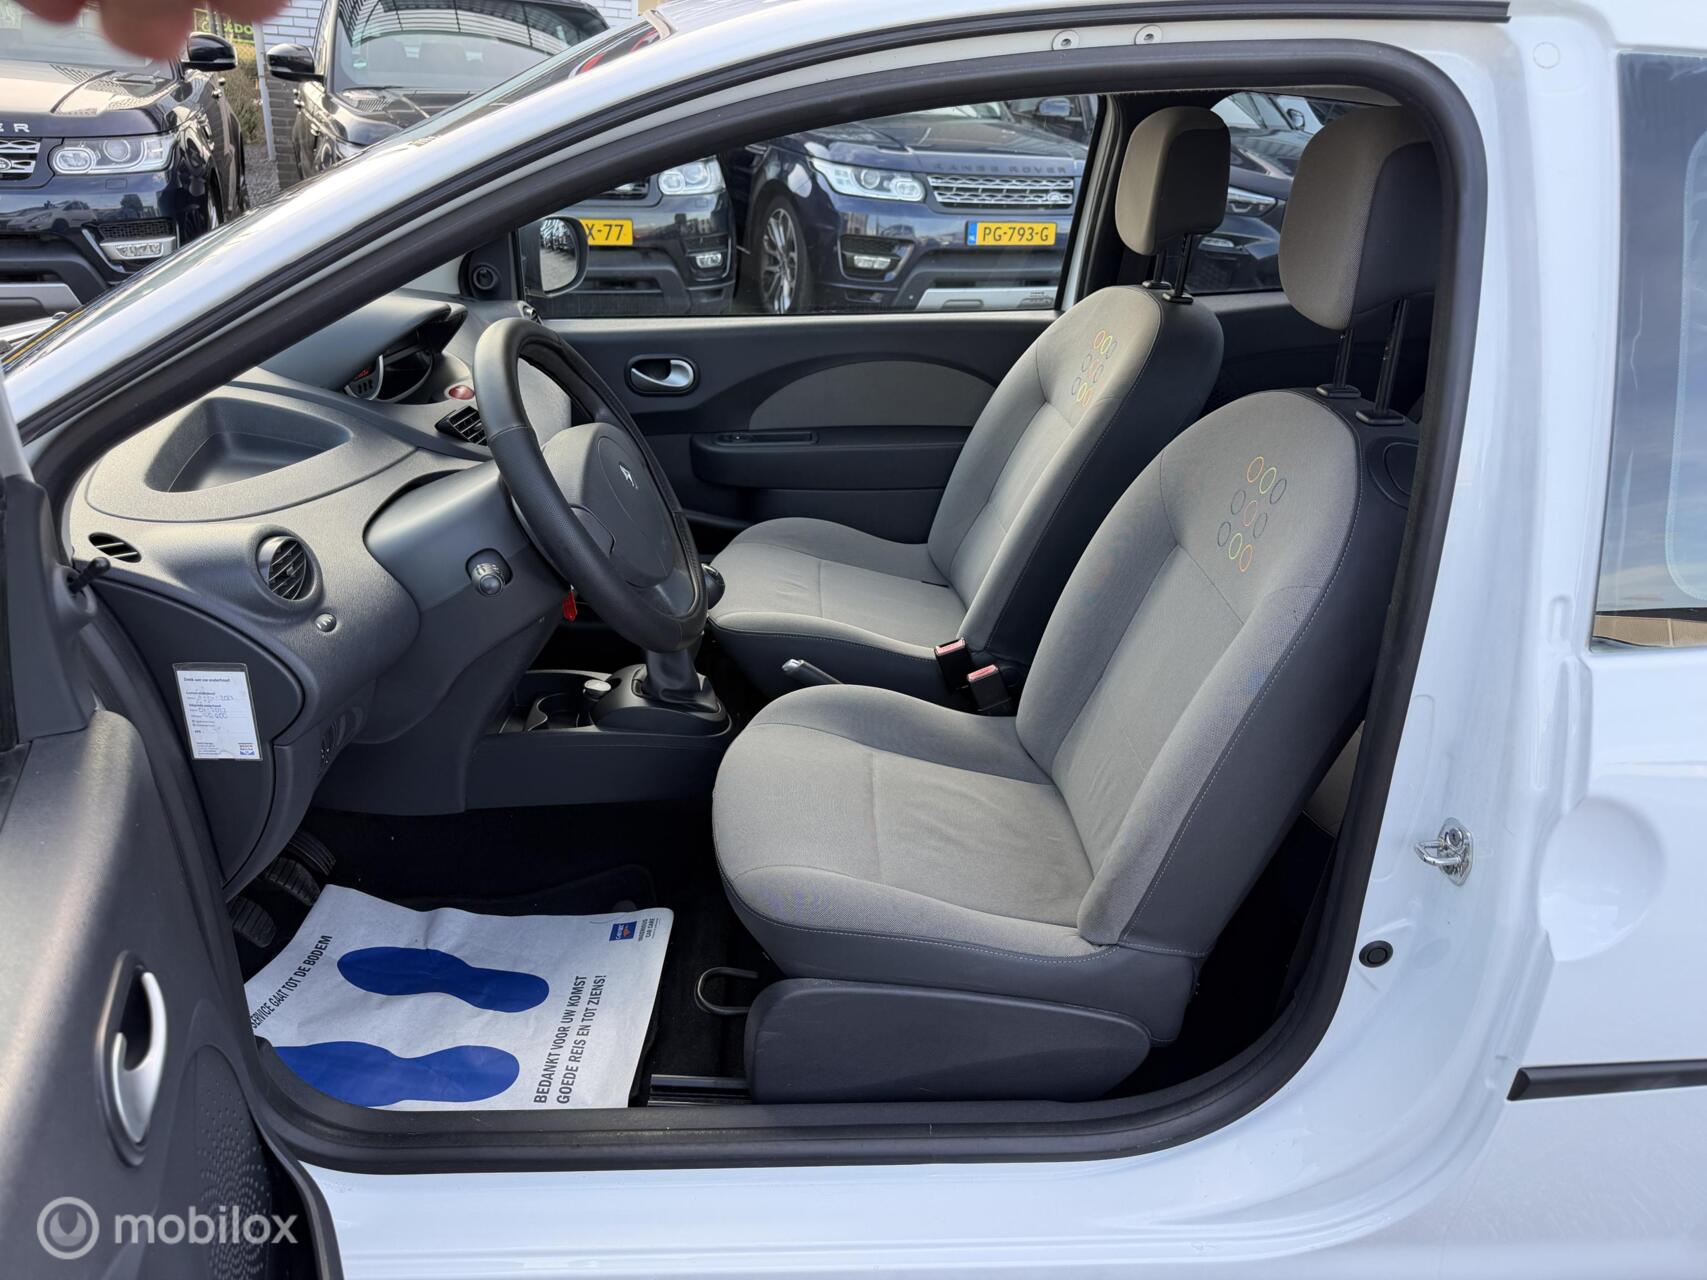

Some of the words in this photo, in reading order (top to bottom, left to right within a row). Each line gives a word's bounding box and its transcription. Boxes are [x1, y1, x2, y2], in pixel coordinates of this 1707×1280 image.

[983, 226, 1049, 242] PG-793-G
[251, 1002, 275, 1028] SERVICE
[268, 989, 289, 1007] GAAT
[281, 977, 301, 991] TOT
[294, 966, 311, 977] DE
[303, 935, 333, 966] BODEM
[567, 976, 587, 1007] KOMST
[588, 975, 606, 1005] ZIENS!
[560, 1009, 576, 1023] UW
[581, 1008, 597, 1022] TOT
[550, 1026, 570, 1050] VOOR
[576, 1025, 591, 1036] EN
[568, 1039, 586, 1062] REIS
[533, 1052, 560, 1103] BEDANKT
[556, 1065, 578, 1104] GOEDE
